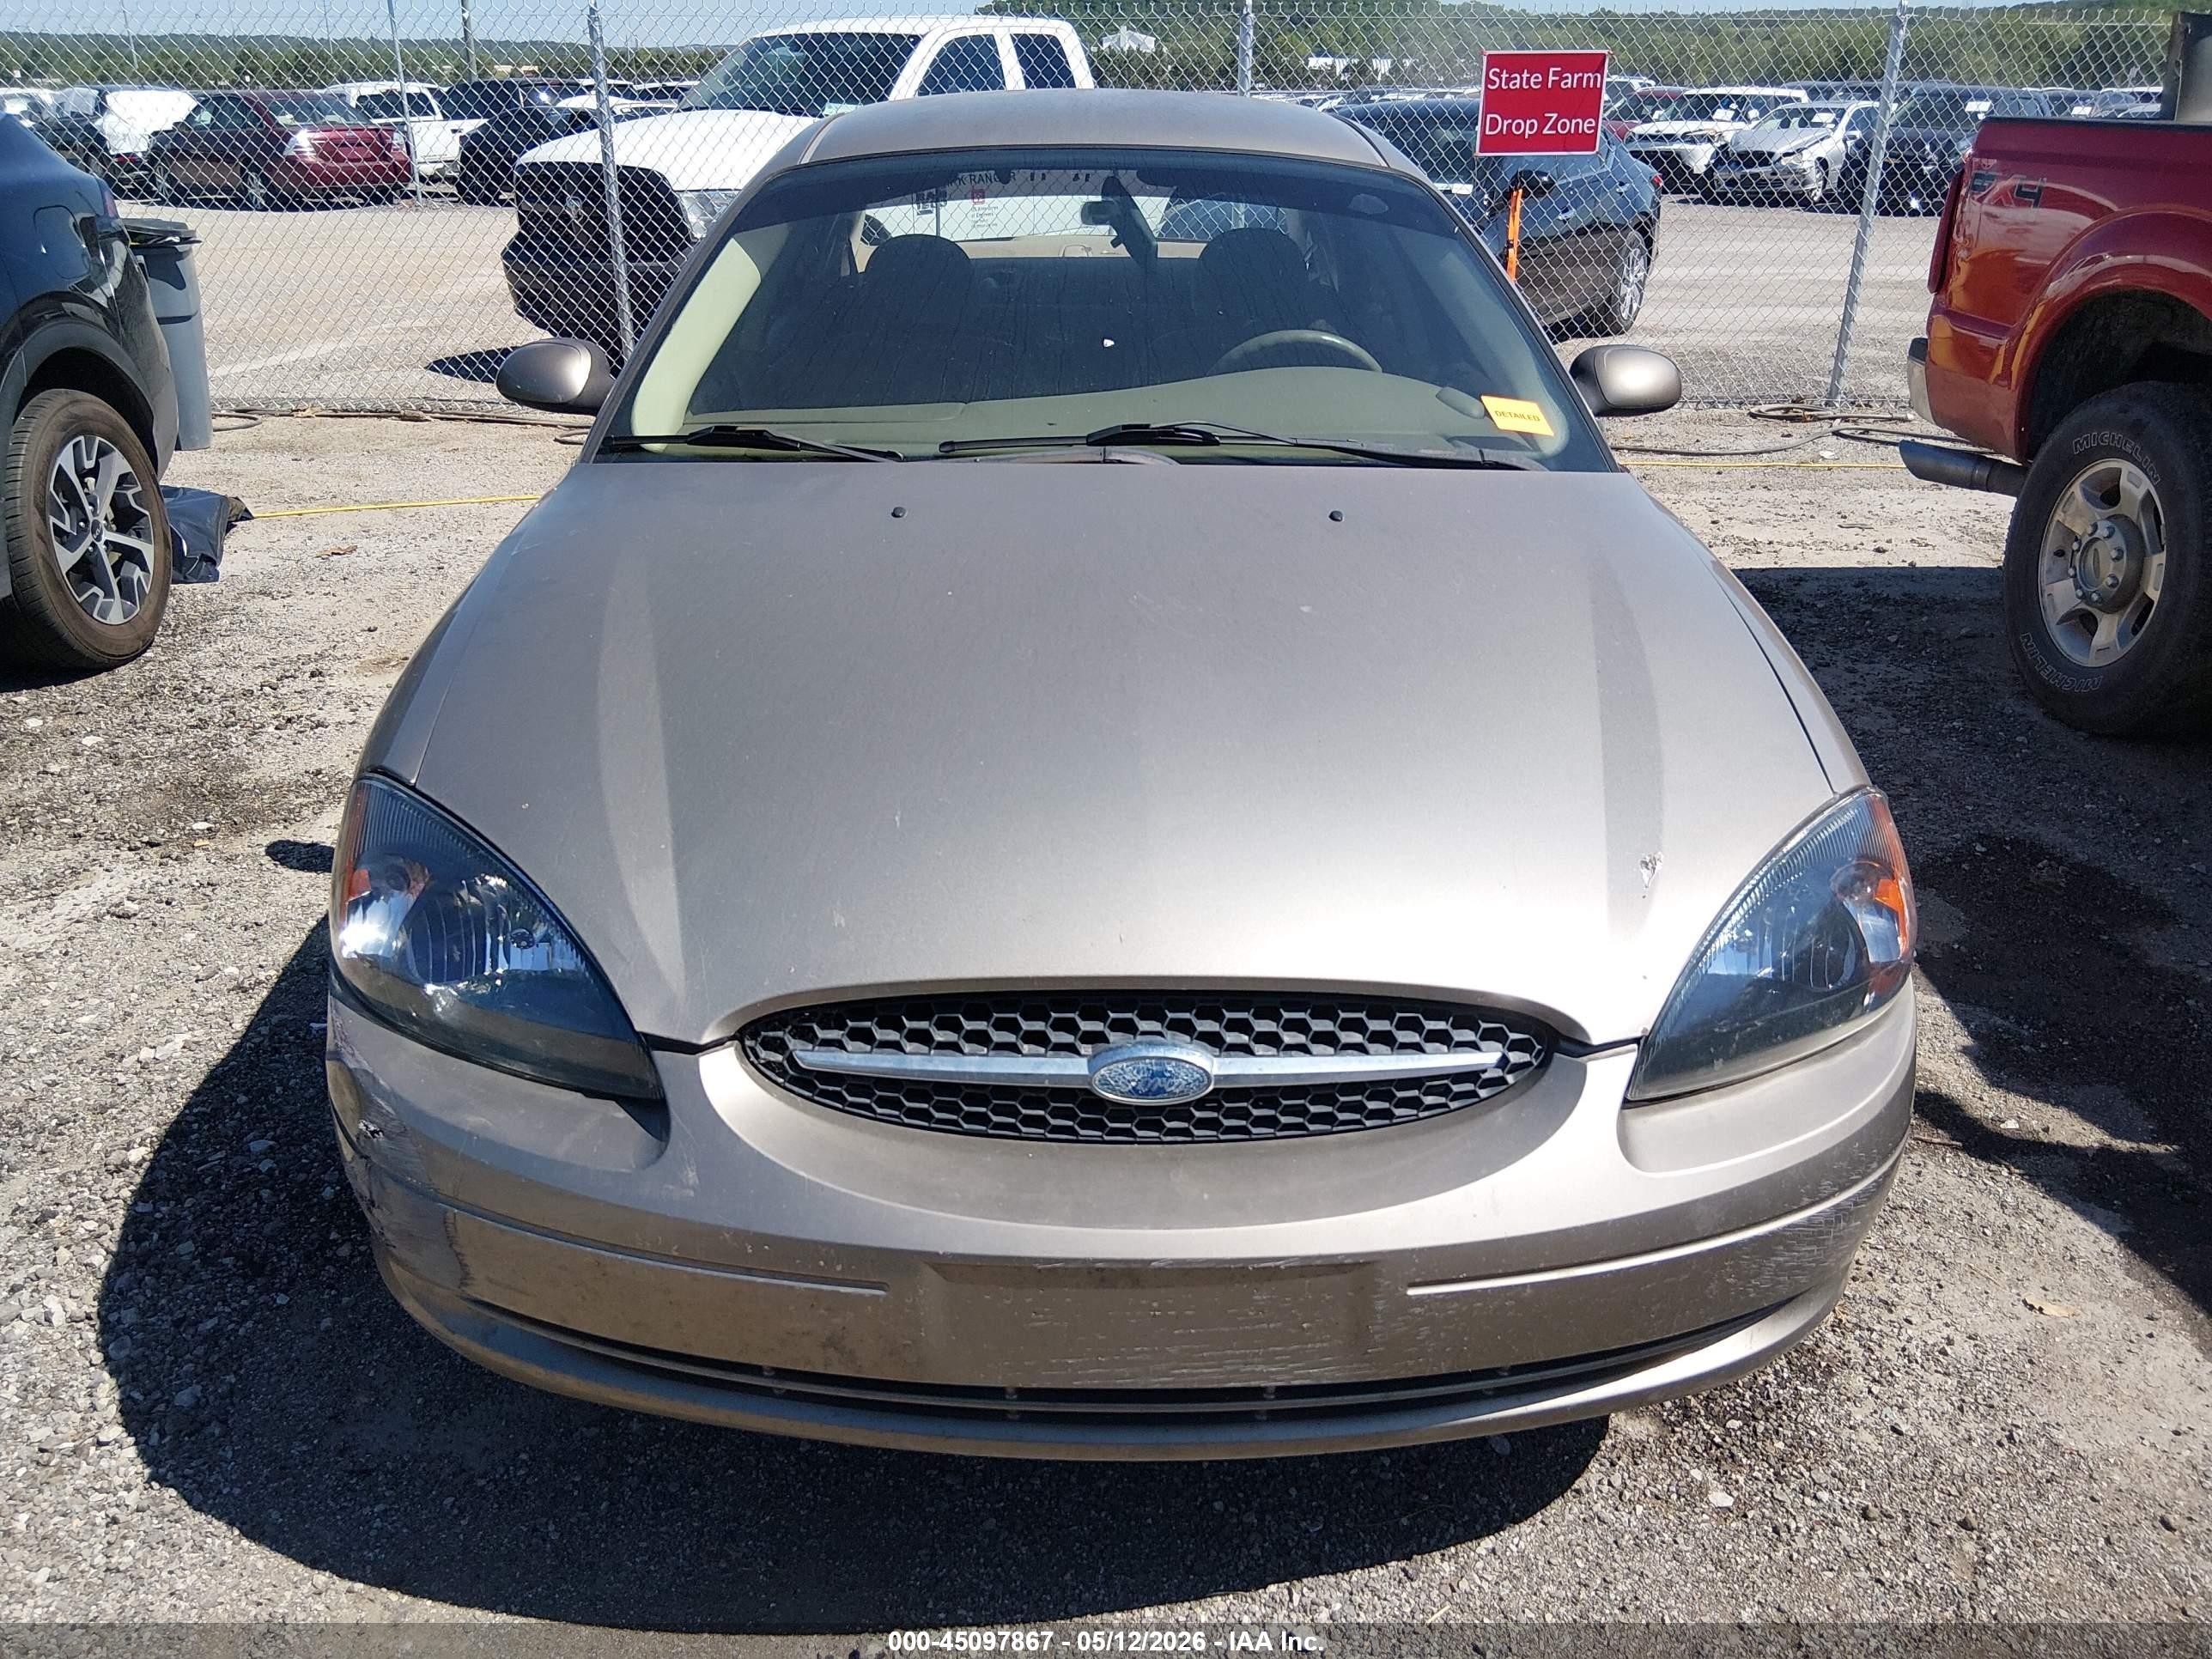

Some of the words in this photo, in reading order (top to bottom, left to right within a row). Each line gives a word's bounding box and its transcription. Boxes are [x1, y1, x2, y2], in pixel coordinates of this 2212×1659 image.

[1487, 68, 1542, 89] State
[1547, 67, 1601, 88] Farm
[1485, 113, 1538, 139] Drop
[1542, 112, 1595, 134] Zone
[1494, 410, 1540, 422] DETAILED
[2072, 431, 2161, 486] MICHELIN
[2020, 632, 2103, 692] MICHELIN
